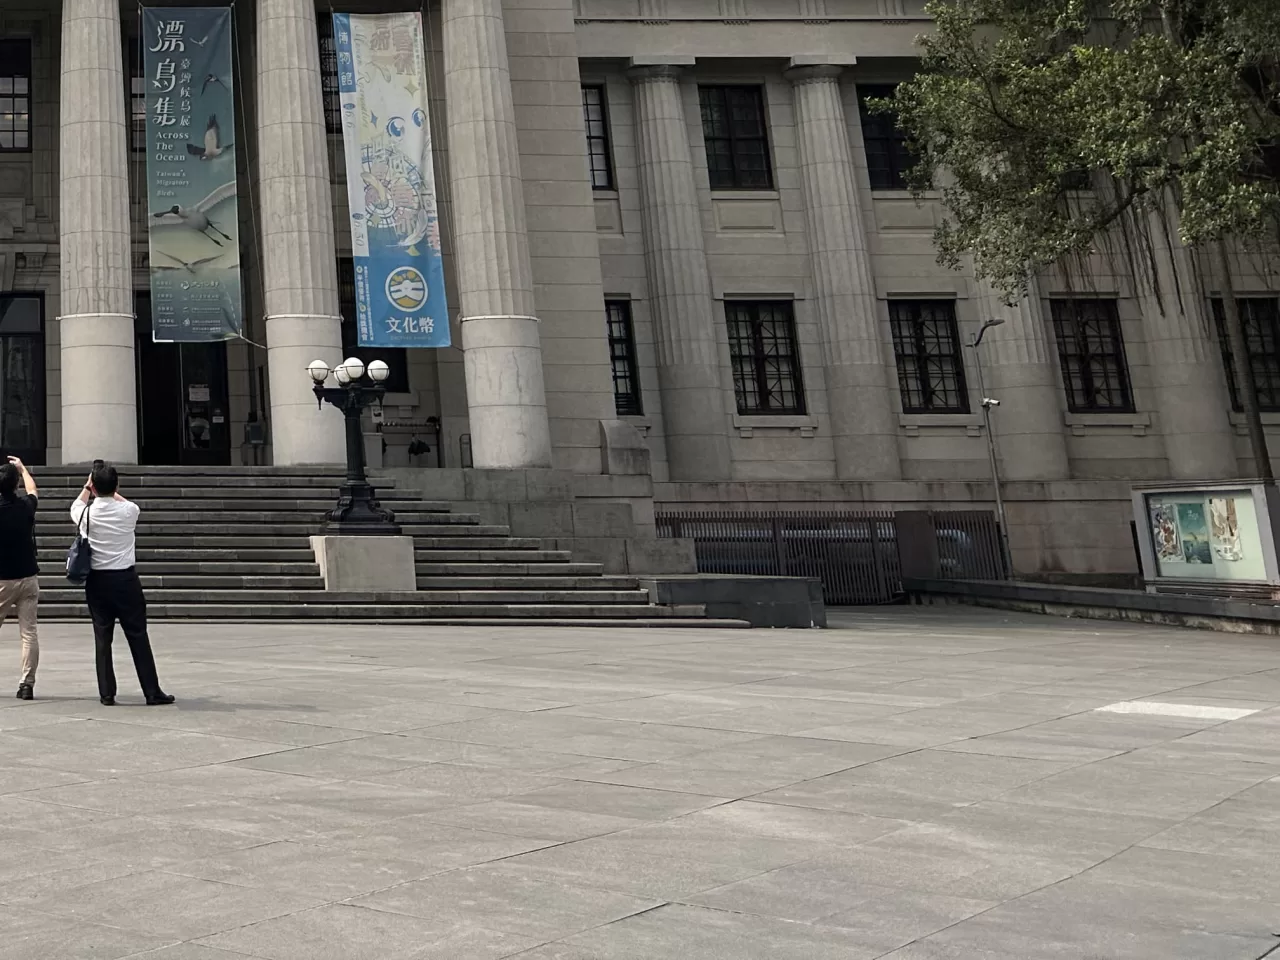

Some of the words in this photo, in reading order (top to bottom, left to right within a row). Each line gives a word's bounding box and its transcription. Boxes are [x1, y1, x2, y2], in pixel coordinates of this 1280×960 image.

[338, 31, 353, 86] 博物館
[149, 20, 186, 127] 漂鳥集
[156, 131, 189, 139] Across
[156, 142, 173, 150] The
[156, 153, 186, 161] Ocean
[156, 179, 189, 187] Migratory
[385, 316, 434, 334] 文化幣
